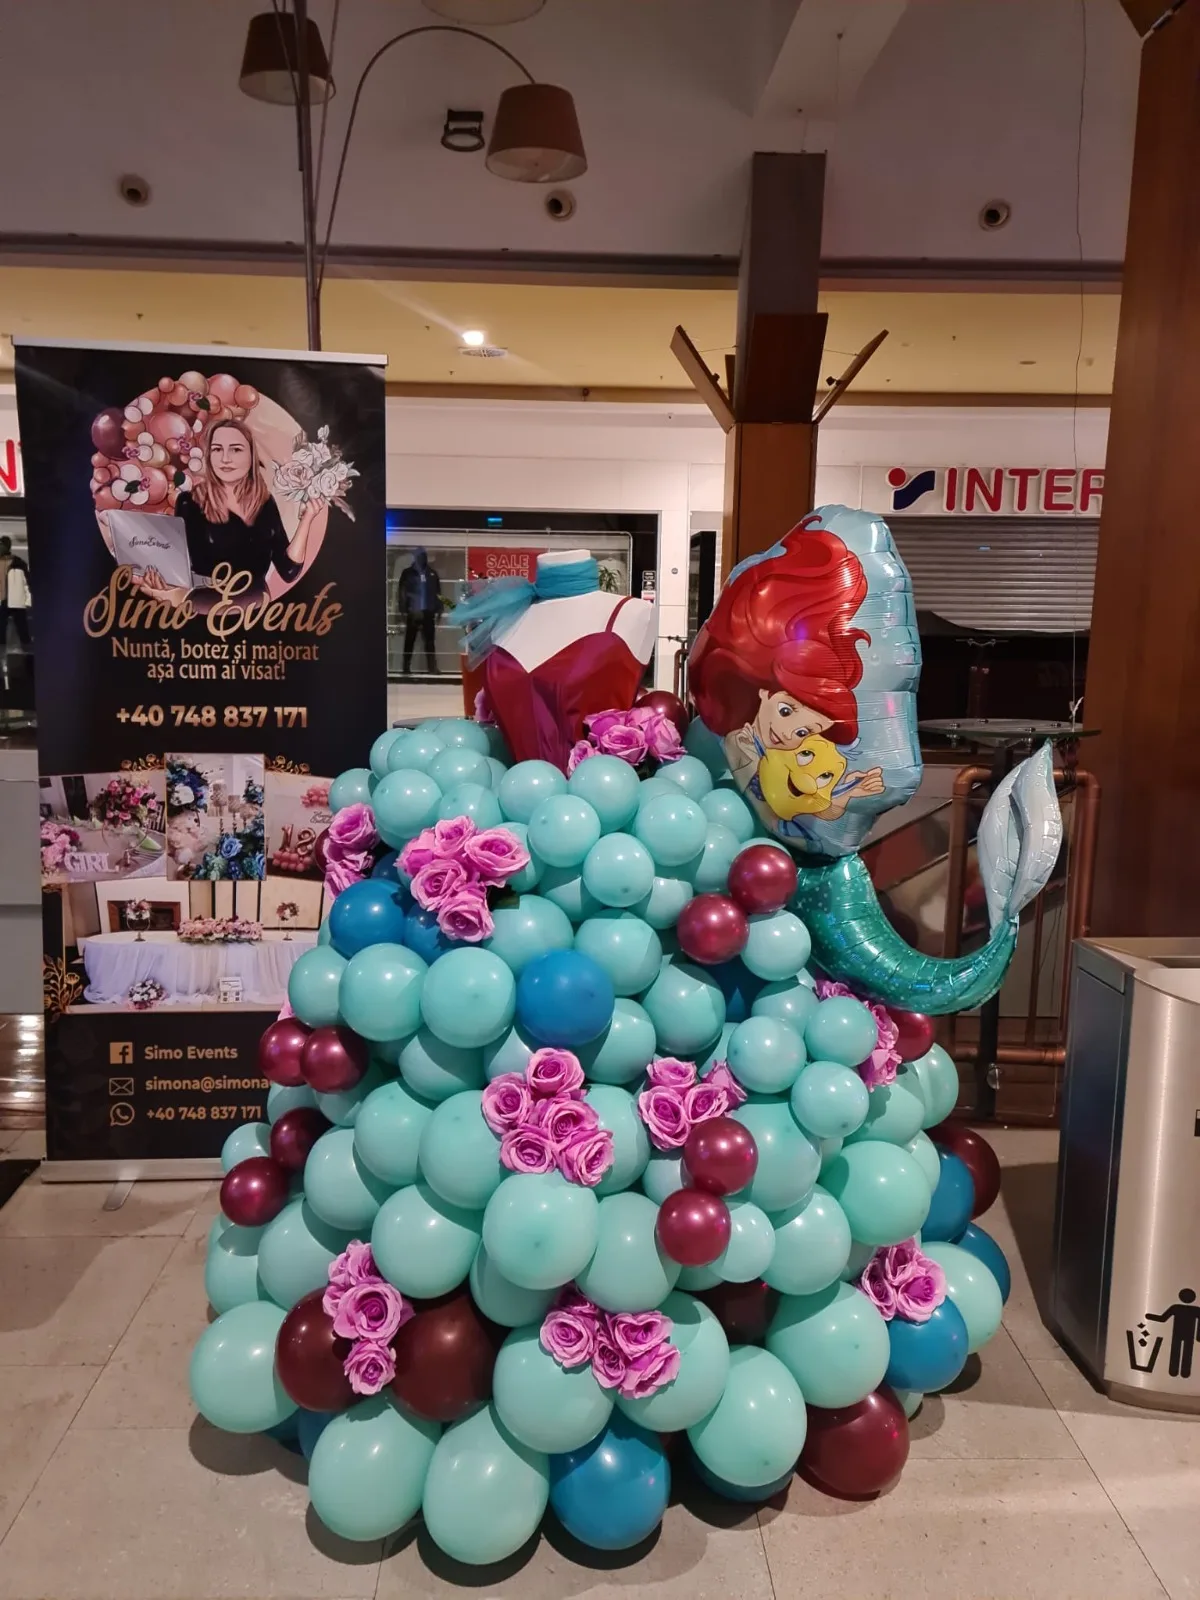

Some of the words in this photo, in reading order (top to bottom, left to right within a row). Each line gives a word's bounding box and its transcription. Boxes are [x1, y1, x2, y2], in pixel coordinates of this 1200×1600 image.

[486, 554, 529, 568] SALE
[84, 564, 198, 638] Simo
[207, 562, 344, 642] Events
[111, 637, 175, 662] Nuntă,
[181, 638, 229, 660] botez
[252, 640, 319, 664] majorat
[147, 663, 174, 684] așa
[179, 664, 217, 680] cum
[221, 660, 236, 680] ai
[241, 660, 286, 680] visat!
[116, 705, 164, 727] +40
[171, 705, 217, 728] 748
[223, 706, 268, 728] 837
[274, 706, 307, 728] 171
[144, 1045, 183, 1060] Simo
[187, 1046, 238, 1060] Events
[145, 1075, 273, 1093] simona@simona
[147, 1107, 175, 1121] +40
[179, 1106, 207, 1120] 748
[210, 1106, 237, 1120] 837
[241, 1105, 262, 1119] 171
